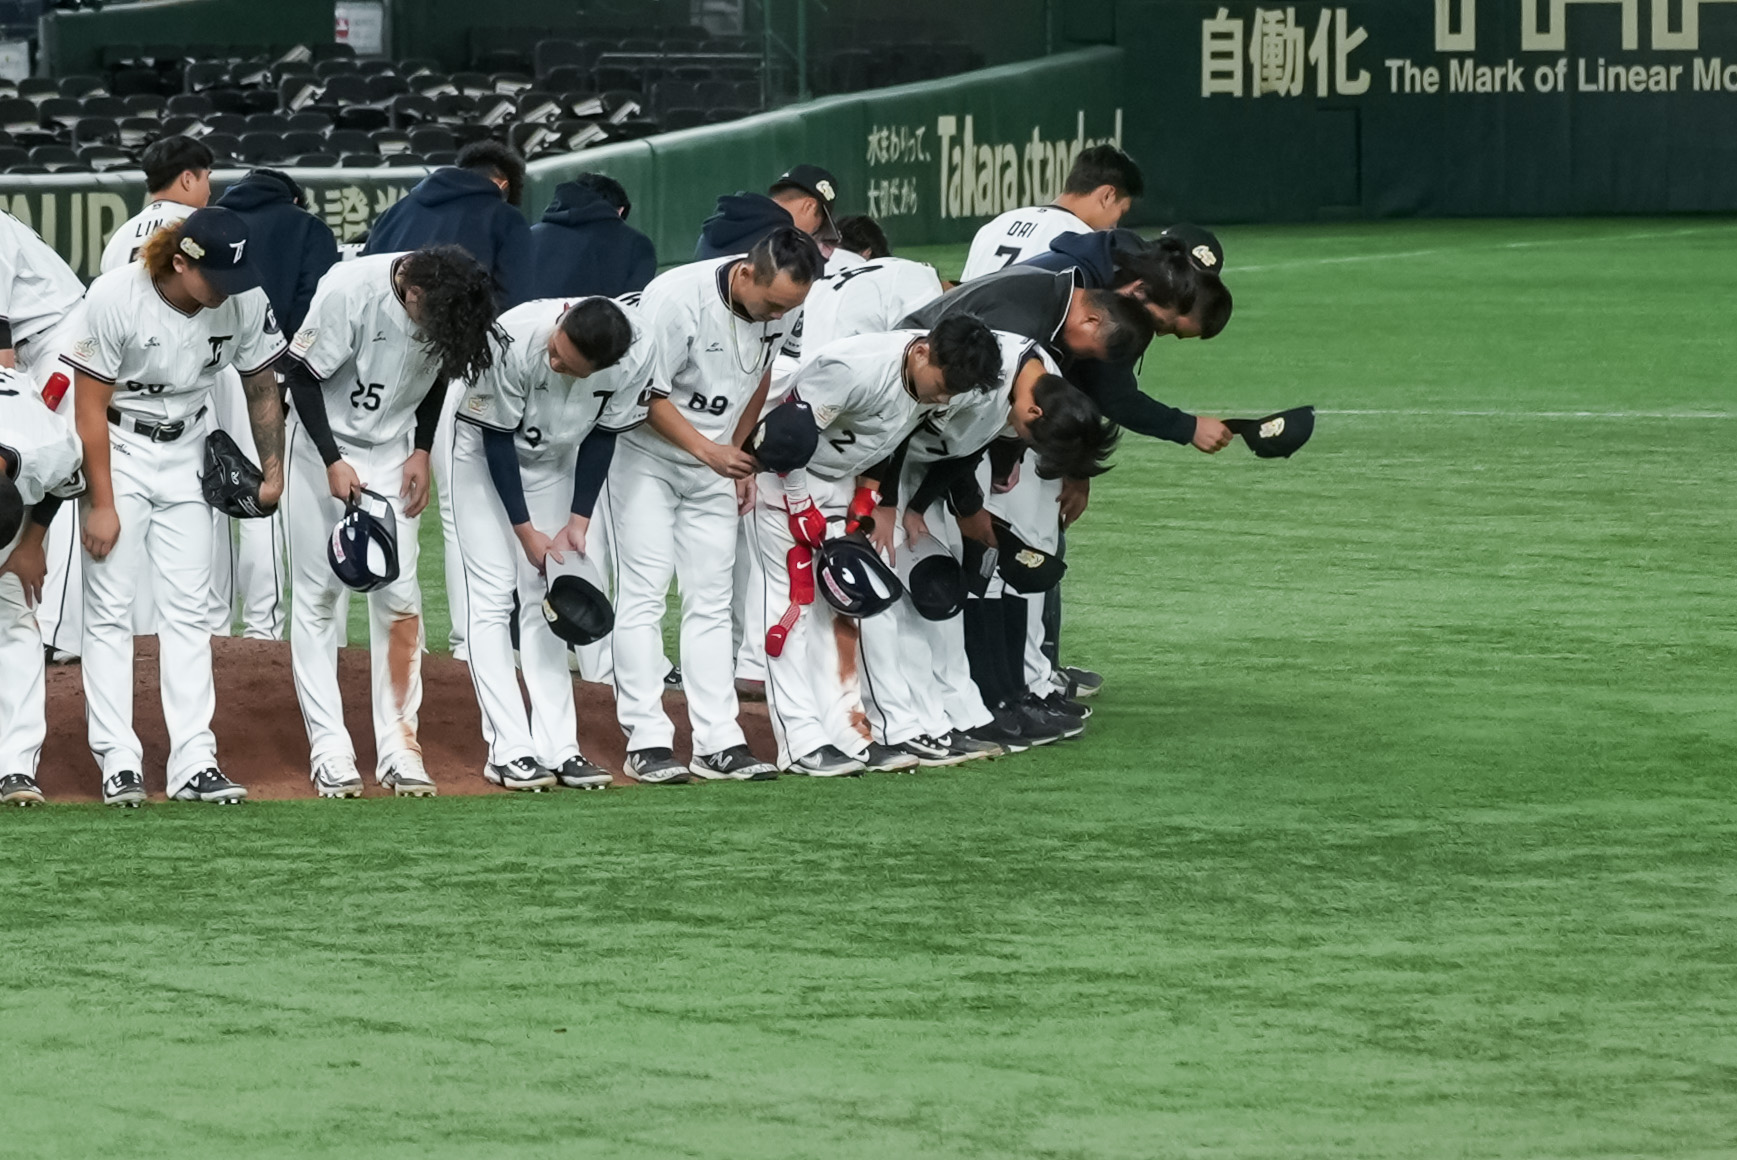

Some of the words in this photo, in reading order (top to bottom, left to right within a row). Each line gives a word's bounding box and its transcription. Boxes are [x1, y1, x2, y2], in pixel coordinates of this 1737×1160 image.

[1201, 6, 1371, 99] 自働化
[1385, 59, 1440, 93] The
[1449, 57, 1524, 92] Mark
[1534, 57, 1568, 92] of
[1578, 55, 1683, 92] Linear
[937, 114, 1018, 219] Takara
[350, 379, 386, 412] 25
